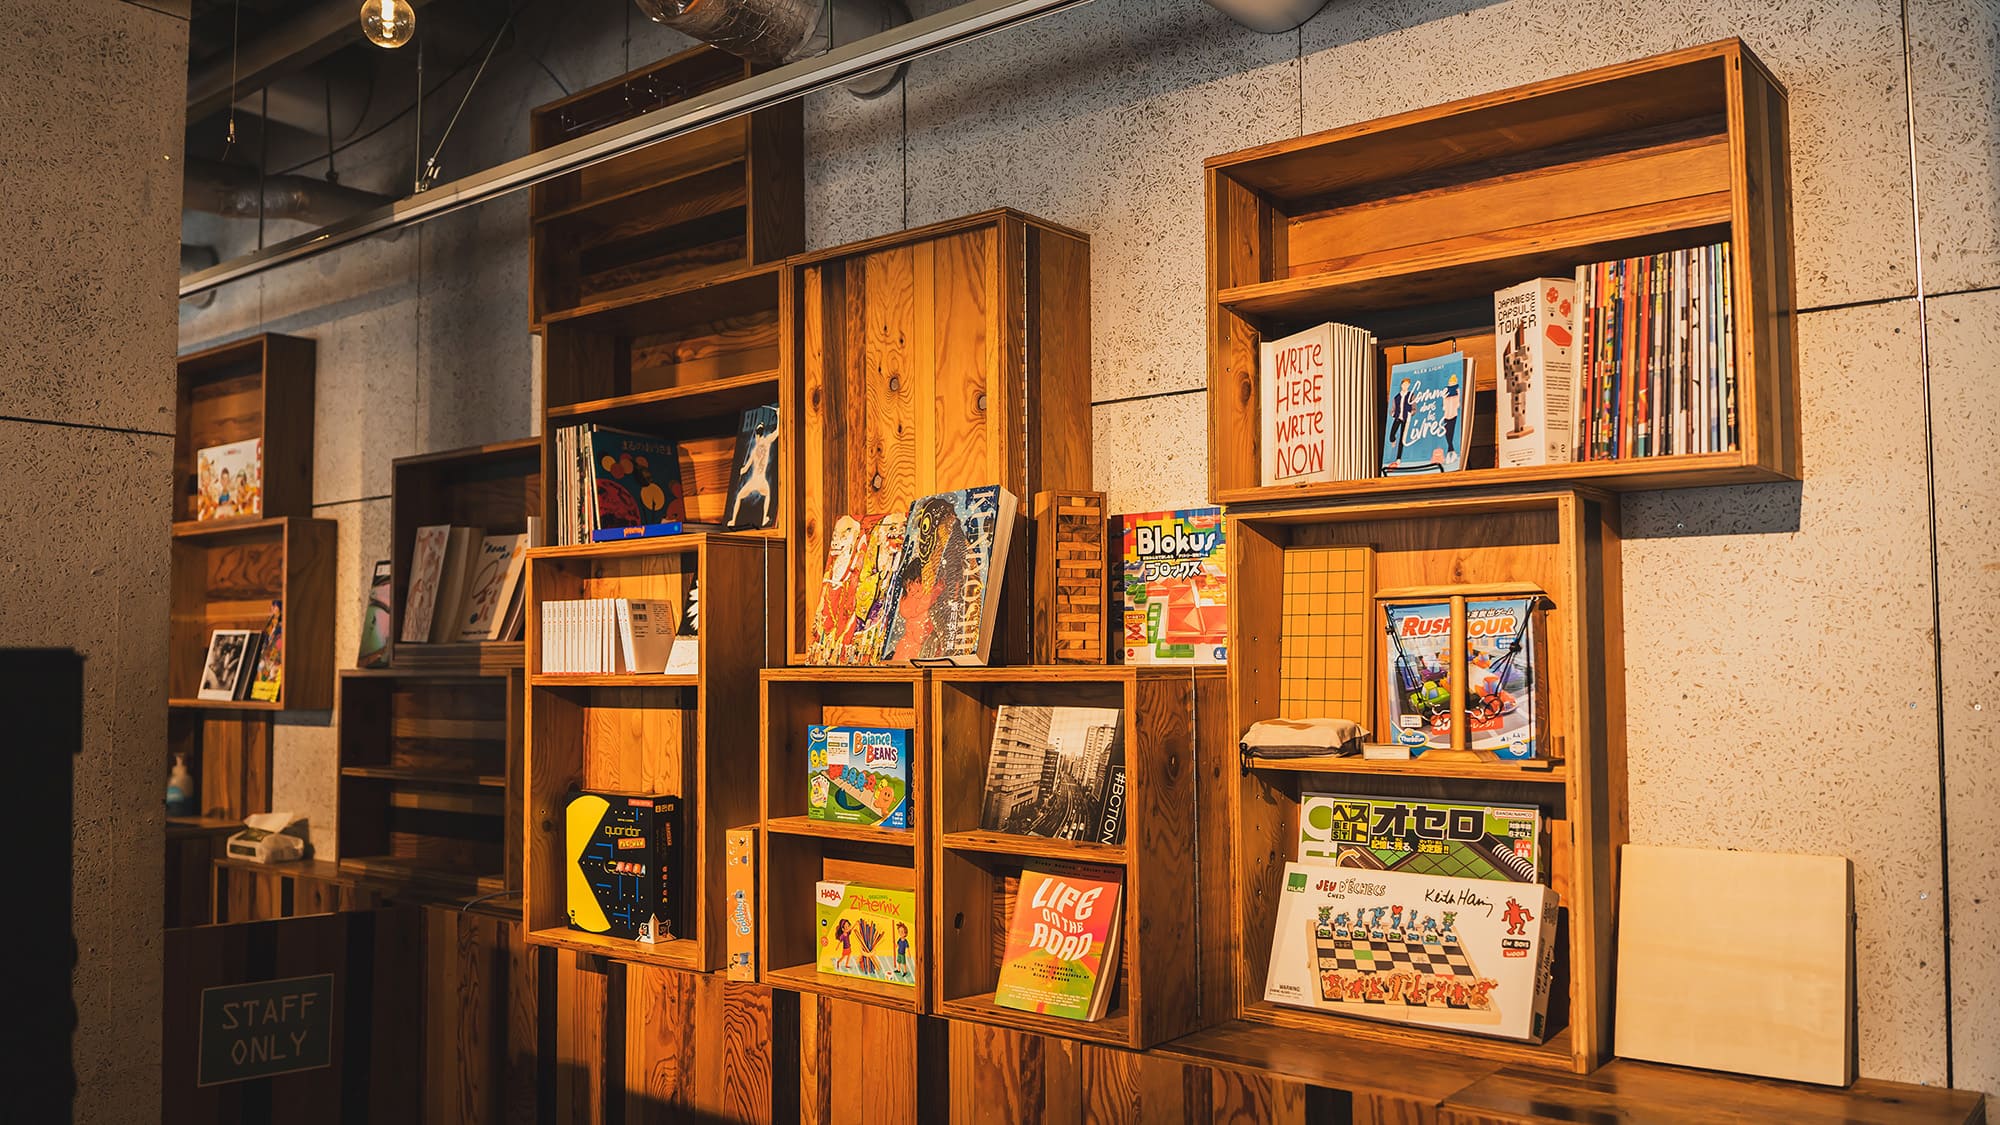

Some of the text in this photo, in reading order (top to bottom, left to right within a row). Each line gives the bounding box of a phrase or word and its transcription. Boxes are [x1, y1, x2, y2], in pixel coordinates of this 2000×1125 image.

[1497, 302, 1536, 321] CAPSULE
[1498, 291, 1536, 310] JAPANESE
[1497, 314, 1537, 336] TOWER
[1276, 374, 1323, 413] HERE
[1408, 380, 1449, 405] Comme
[1402, 412, 1448, 446] Livres
[1276, 440, 1325, 478] NOW
[1136, 524, 1217, 557] Blokus
[1145, 560, 1202, 581] ブロックス
[1467, 617, 1515, 636] OUR
[854, 732, 891, 754] Balance
[866, 745, 898, 763] BEANS
[604, 825, 642, 838] quoridor
[1371, 802, 1485, 842] オセロ
[821, 889, 841, 900] HABA
[1316, 879, 1337, 892] JEU
[1425, 888, 1456, 905] Keith
[1031, 877, 1104, 921] LIFE
[1061, 916, 1084, 934] THE
[1029, 922, 1093, 961] ROAD
[222, 992, 319, 1030] STAFF
[231, 1029, 307, 1065] ONLY
